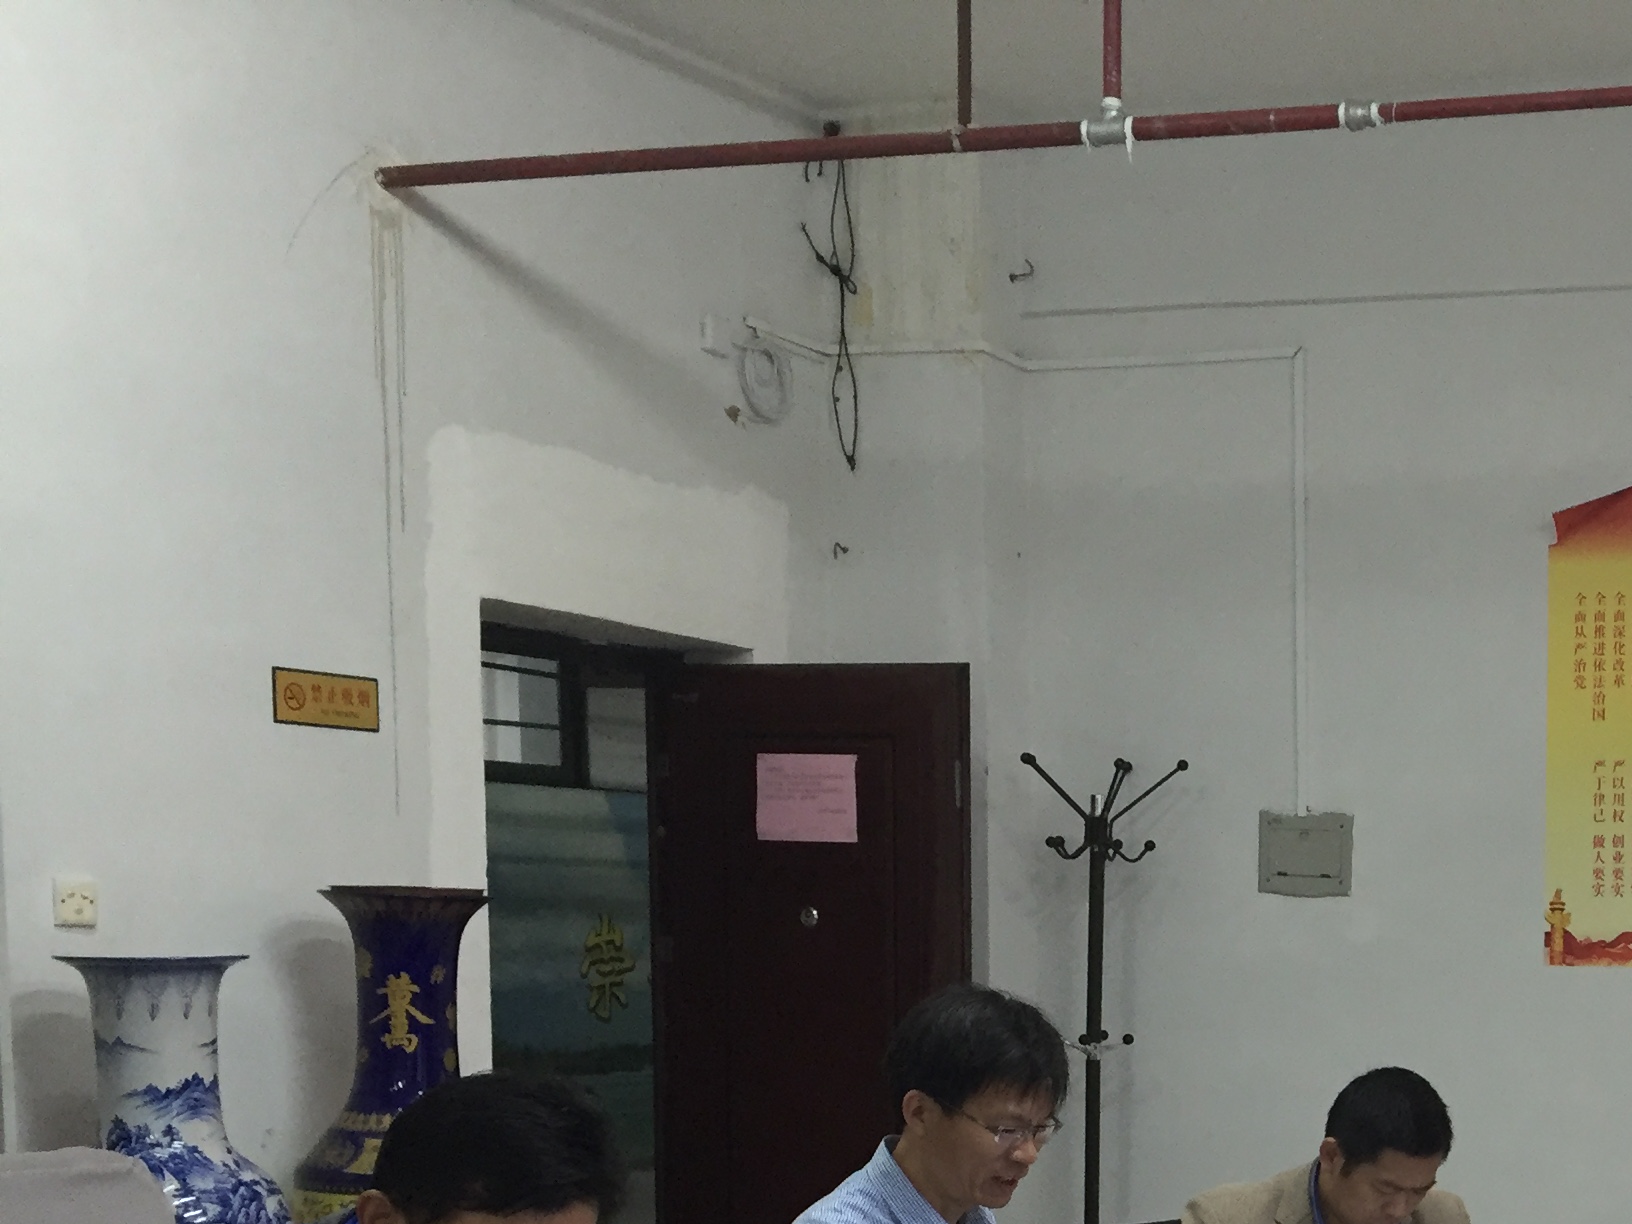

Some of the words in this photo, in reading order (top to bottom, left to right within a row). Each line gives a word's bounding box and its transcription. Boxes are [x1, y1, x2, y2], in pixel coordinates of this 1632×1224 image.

[1573, 592, 1587, 690] 全面从严治党
[1592, 591, 1606, 721] 全面推进依法治国
[1612, 591, 1626, 688] 全面深化改革
[1592, 760, 1606, 823] 严于律己
[1611, 760, 1626, 823] 严以用权
[1591, 834, 1606, 898] 做人要实
[1611, 833, 1625, 898] 创业要实
